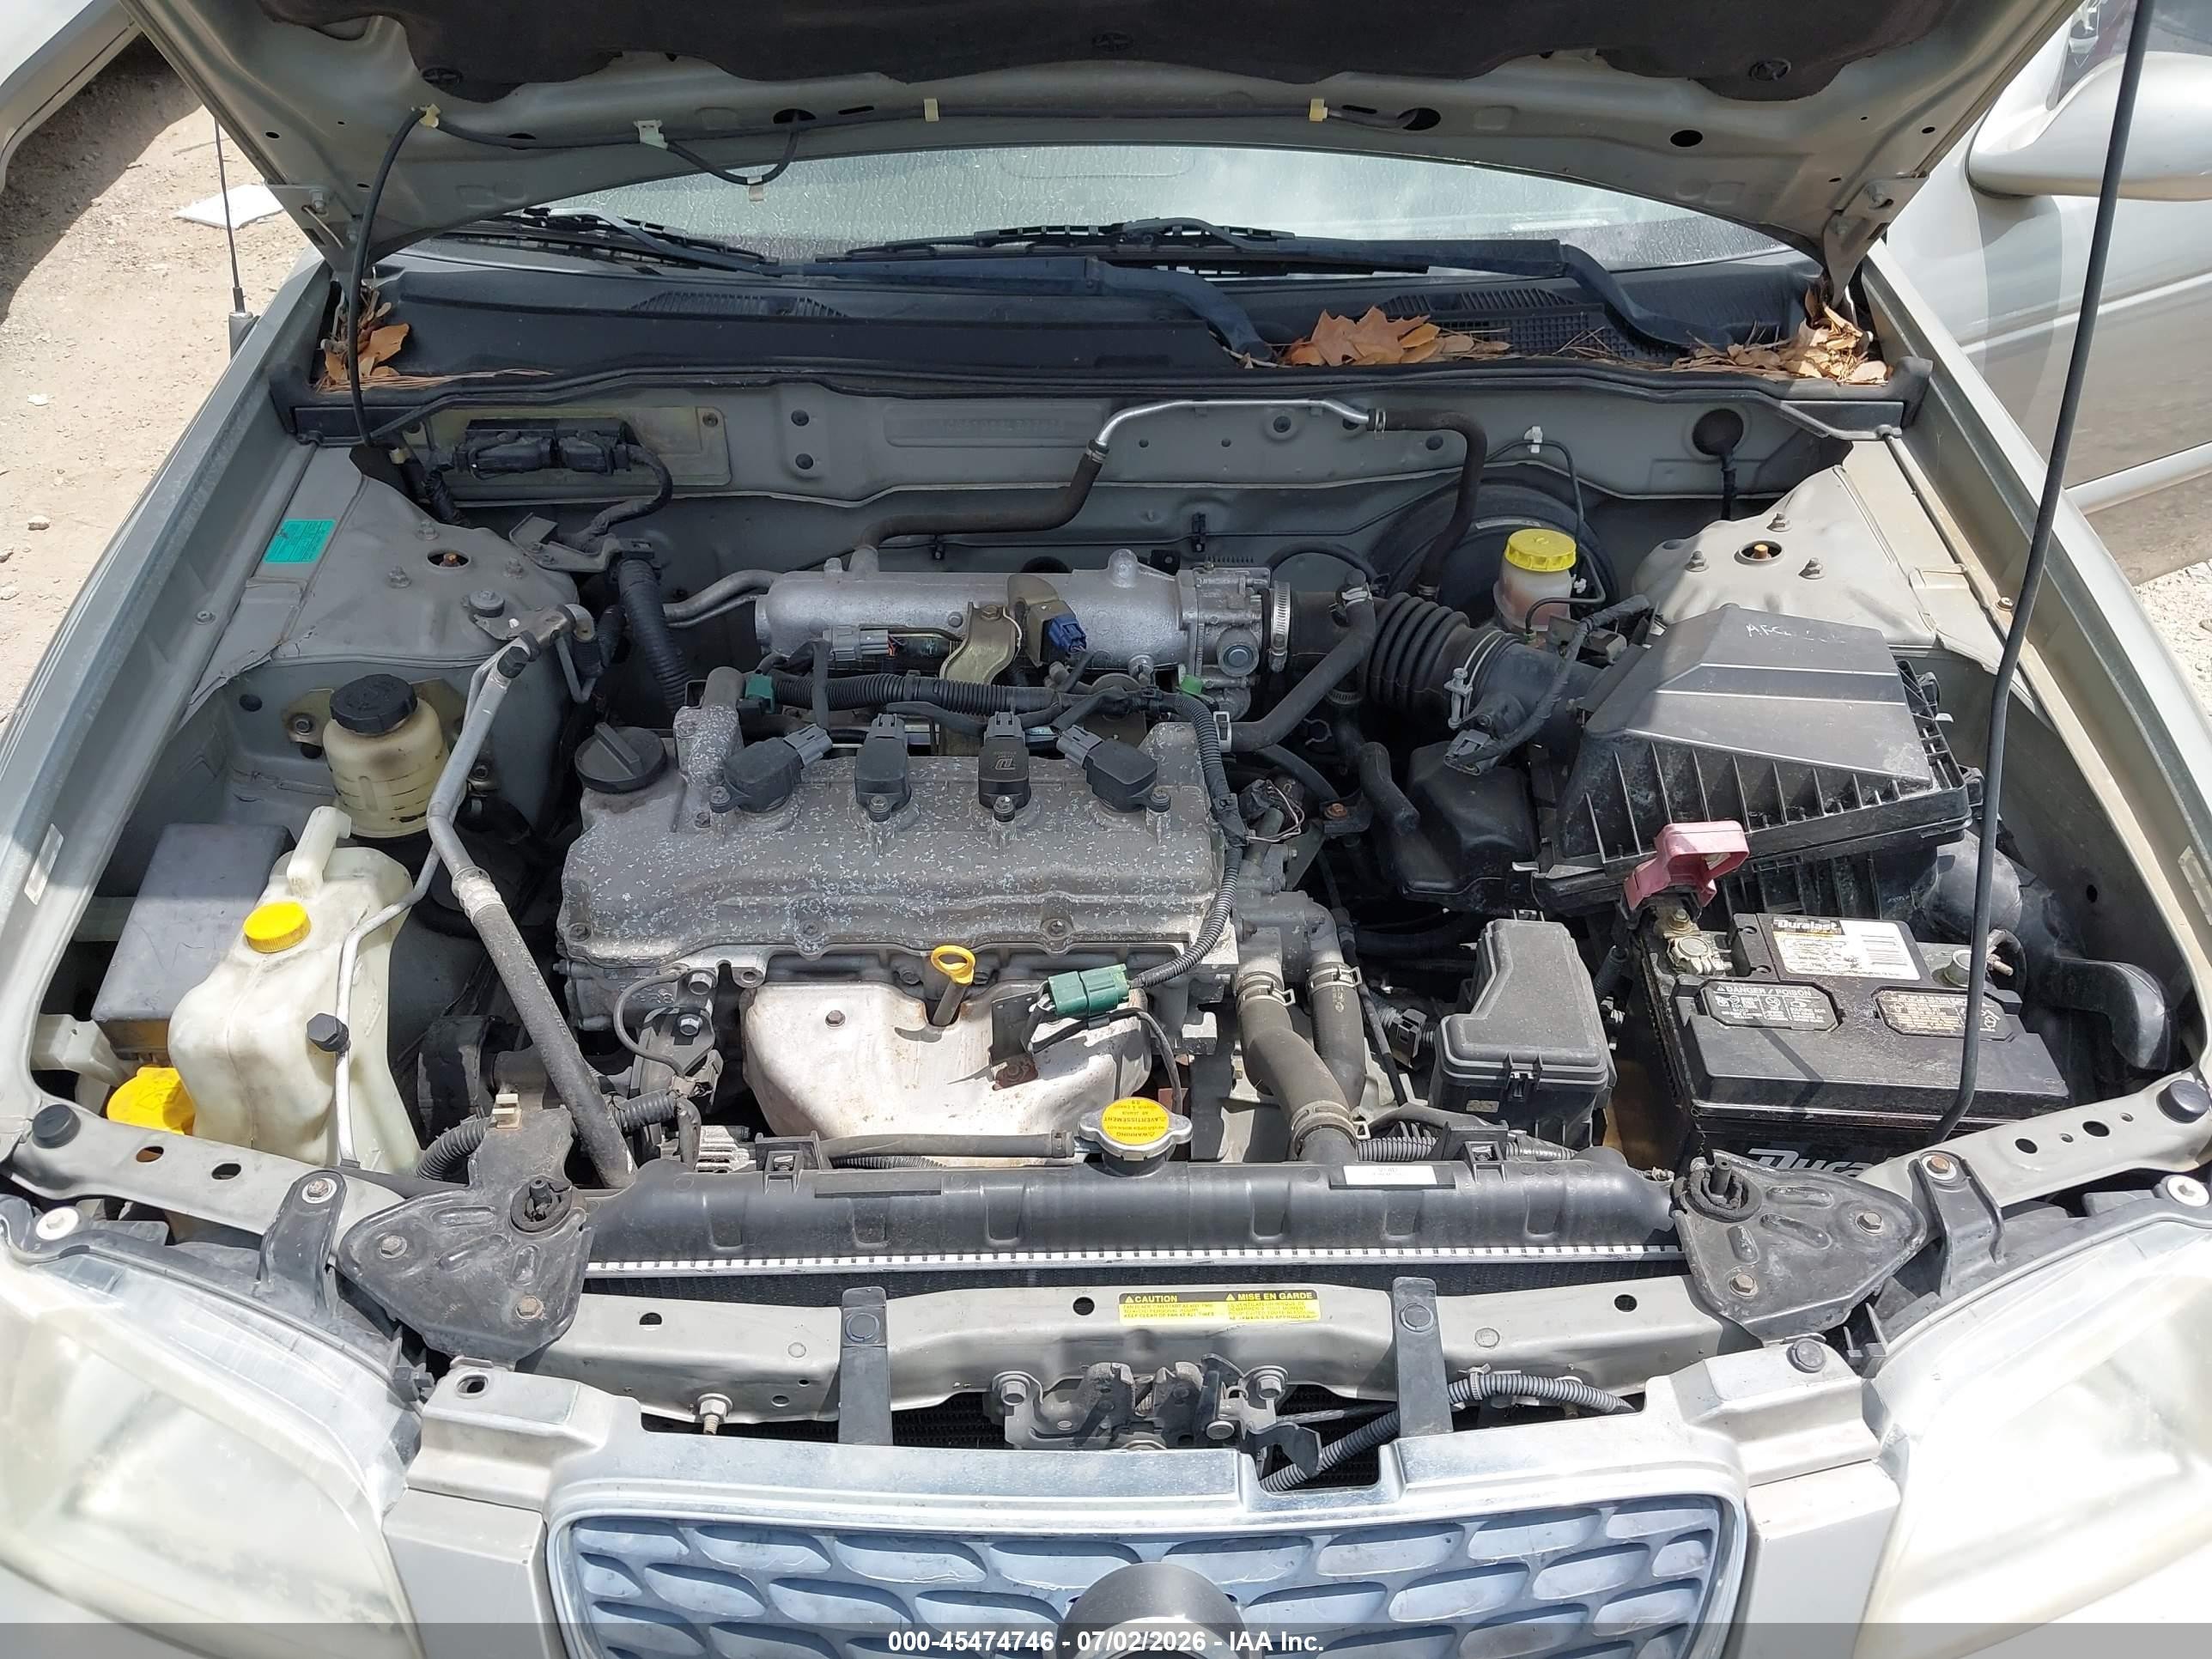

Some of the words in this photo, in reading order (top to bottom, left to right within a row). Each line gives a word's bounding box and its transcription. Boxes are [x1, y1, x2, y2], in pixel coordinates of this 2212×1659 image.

[1778, 919, 1839, 931] Duralast
[1725, 986, 1765, 994] DANGER
[1775, 988, 1812, 997] POISON
[1237, 1292, 1261, 1301] MISE
[1279, 1291, 1313, 1300] GARDE
